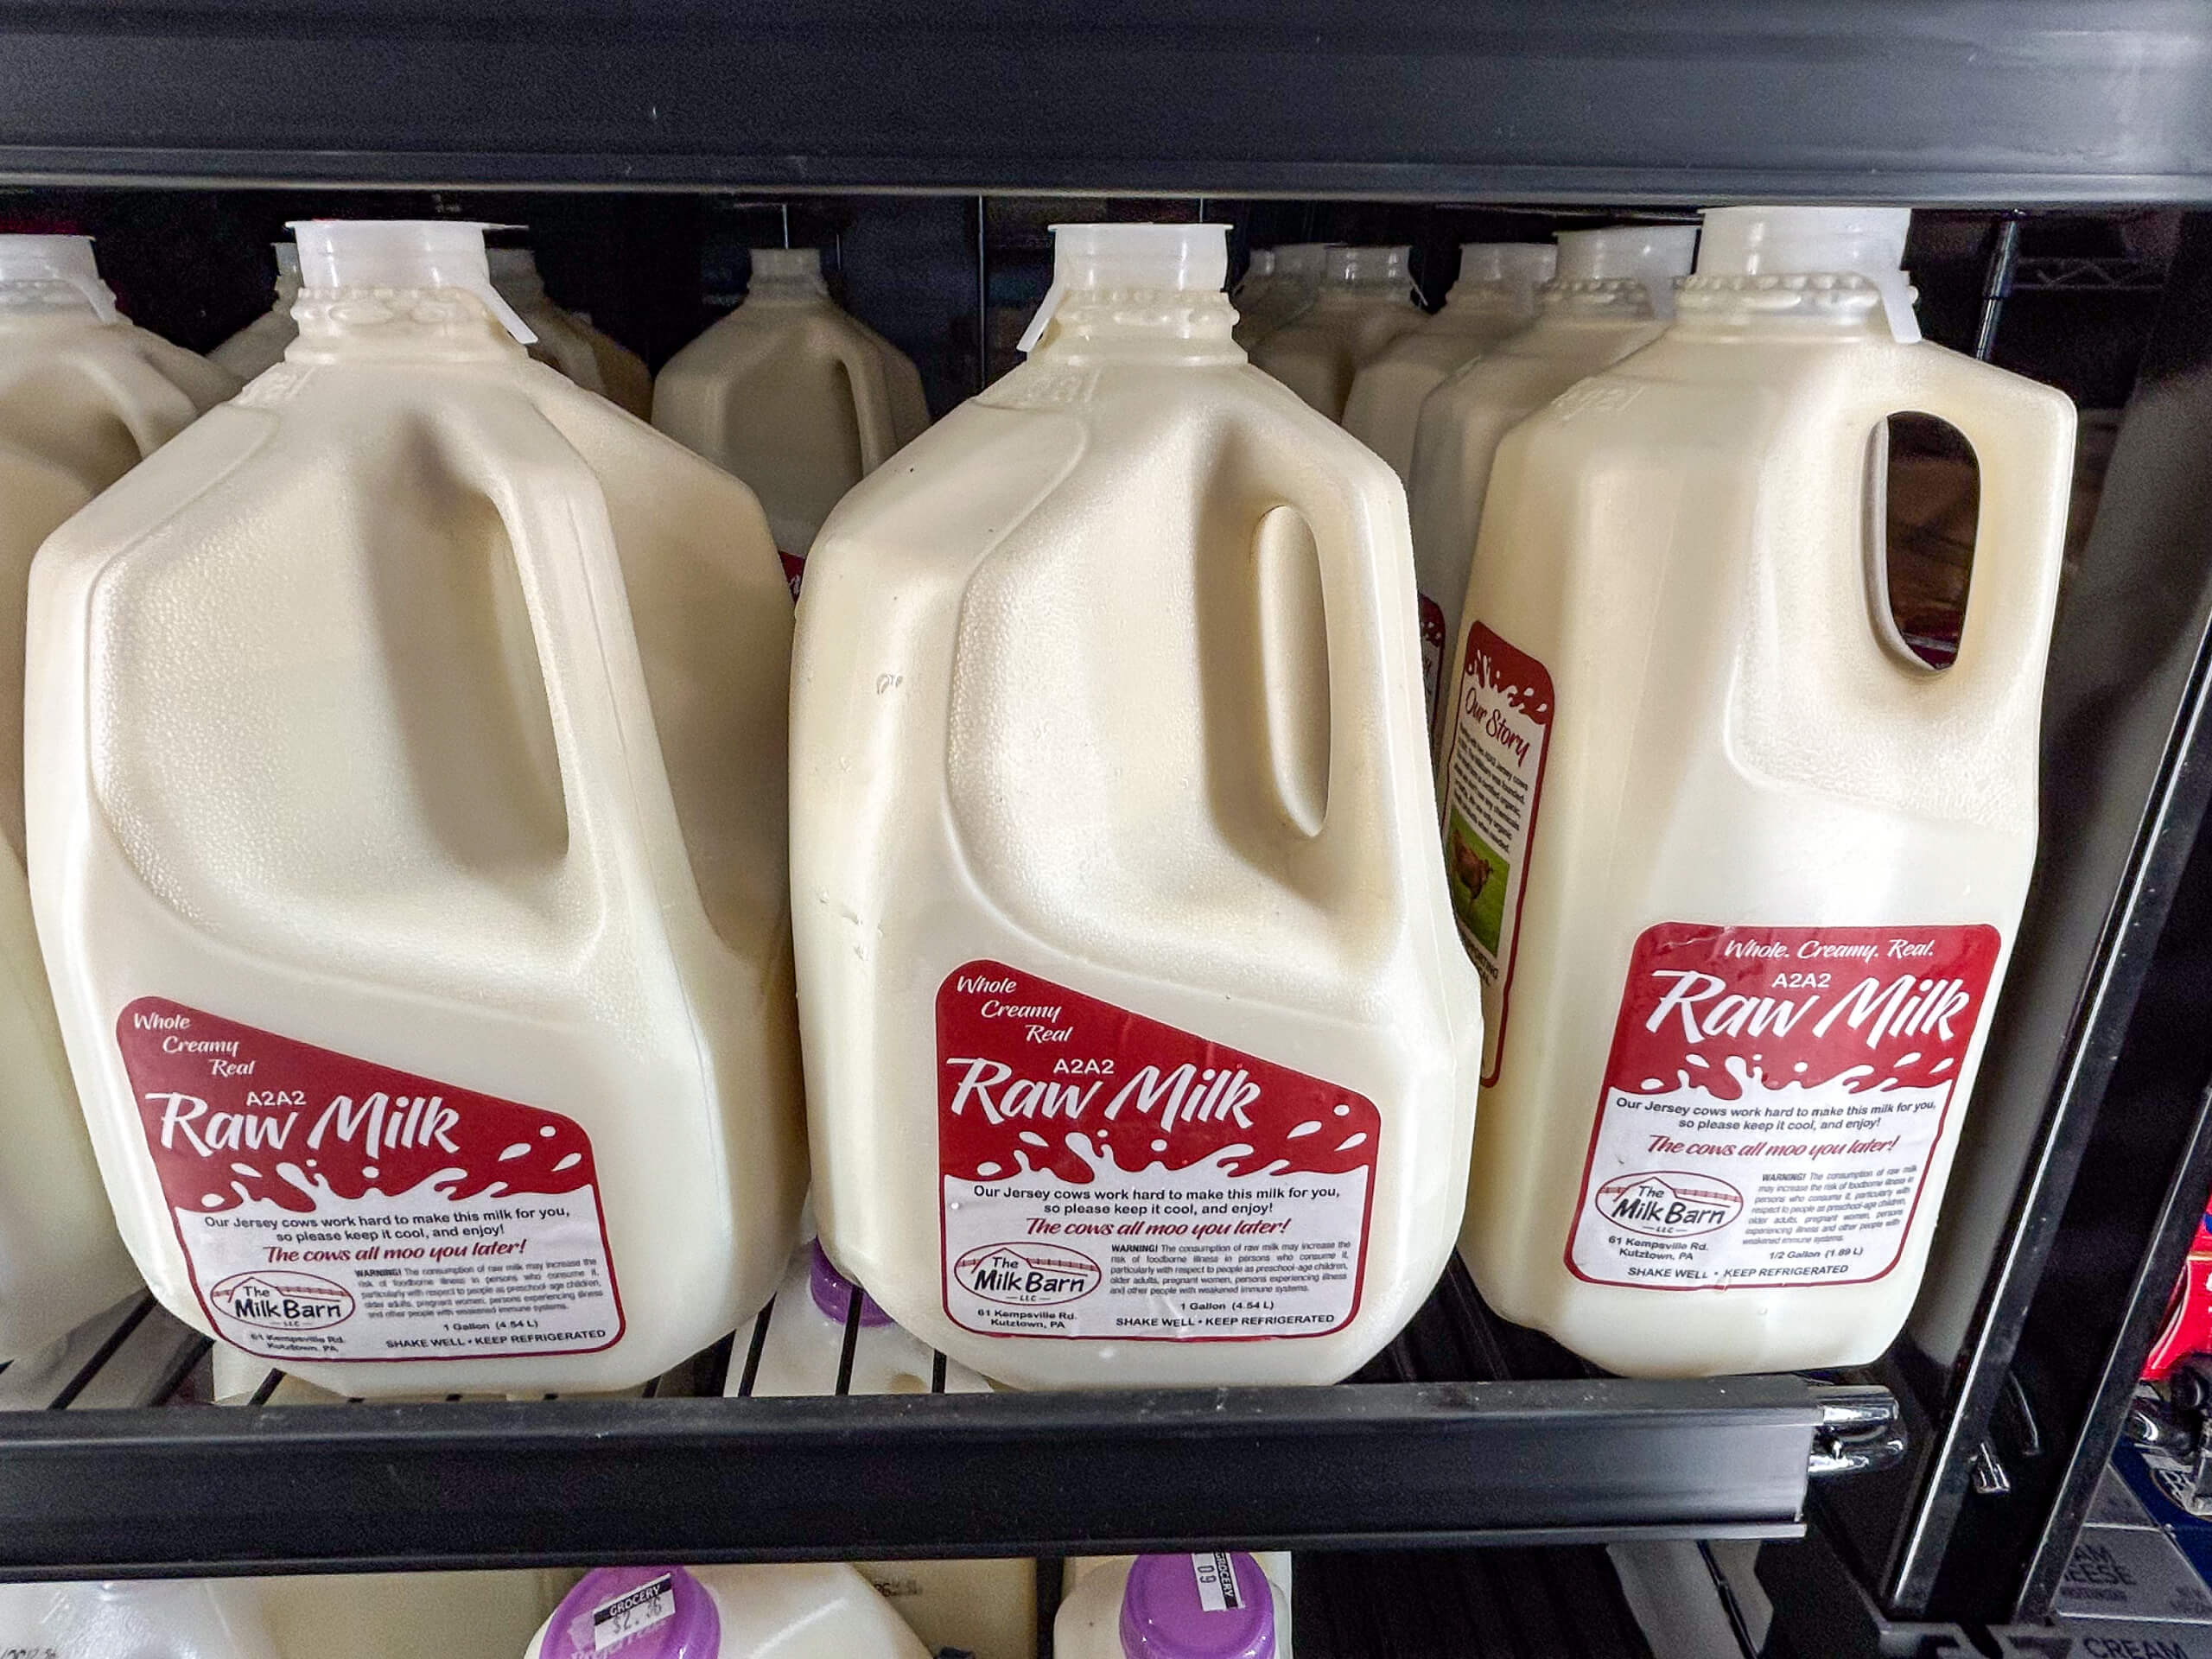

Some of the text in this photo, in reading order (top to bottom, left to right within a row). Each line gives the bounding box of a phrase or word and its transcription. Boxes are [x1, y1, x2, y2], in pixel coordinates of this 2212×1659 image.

[1465, 687, 1488, 723] Our
[1485, 709, 1530, 767] Story
[1725, 939, 1936, 964] Whole. Creamy. Real.
[957, 975, 1017, 994] Whole
[1771, 973, 1831, 988] A2A2
[981, 1000, 1062, 1023] Creamy
[1646, 970, 1969, 1050] Raw Milk
[134, 1012, 191, 1029] Whole
[1025, 1024, 1073, 1044] Real
[162, 1036, 239, 1058] Creamy
[209, 1058, 256, 1077] Real
[1052, 1058, 1115, 1075] A2A2
[246, 1090, 307, 1106] A2A2
[946, 1058, 1261, 1134] Raw Milk
[1617, 1097, 1936, 1117] Our Jersey cows work hard to make this milk for you,
[145, 1092, 461, 1160] Raw Milk
[1698, 1120, 1740, 1132] please
[1743, 1121, 1773, 1132] keep
[1777, 1121, 1784, 1130] it
[1788, 1120, 1816, 1131] cool,
[1821, 1119, 1843, 1129] and
[1846, 1117, 1881, 1130] enjoy!
[1648, 1135, 1901, 1160] The cows all moo you later!
[974, 1185, 1340, 1201] Our Jersey cows work hard to make this milk for you,
[1639, 1185, 1664, 1198] The
[205, 1207, 569, 1230] Our Jersey cows work hard to make this milk for you,
[1044, 1203, 1273, 1216] so please keep it cool, and enjoy!
[1611, 1198, 1725, 1224] Milk Barn
[276, 1224, 505, 1243] so please keep it cool, and enjoy!
[1027, 1217, 1292, 1240] The cows all moo you later!
[263, 1239, 527, 1263] The cows all moo you later!
[1608, 1236, 1622, 1245] 61
[1690, 1243, 1709, 1251] Rd.
[993, 1256, 1019, 1268] The
[1678, 1252, 1694, 1261] PA
[1769, 1251, 1785, 1260] 1/2
[1787, 1250, 1821, 1259] Gallon
[1853, 1247, 1864, 1255] L)
[974, 1269, 1084, 1293] Milk Barn
[1627, 1265, 1849, 1279] SHAKE WELL KEEP REFRIGERATED
[243, 1286, 270, 1297] The
[235, 1299, 341, 1319] Milk Barn
[1263, 1301, 1274, 1310] L)
[453, 1321, 490, 1331] Gallon
[527, 1319, 538, 1329] L)
[1050, 1320, 1065, 1329] PA
[1058, 1312, 1077, 1320] Rd.
[1116, 1314, 1334, 1327] SHAKE WELL KEEP REFRIGERATED
[386, 1329, 606, 1349] SHAKE WELL KEEP REFRIGERATED
[609, 1584, 660, 1617] GROCERY
